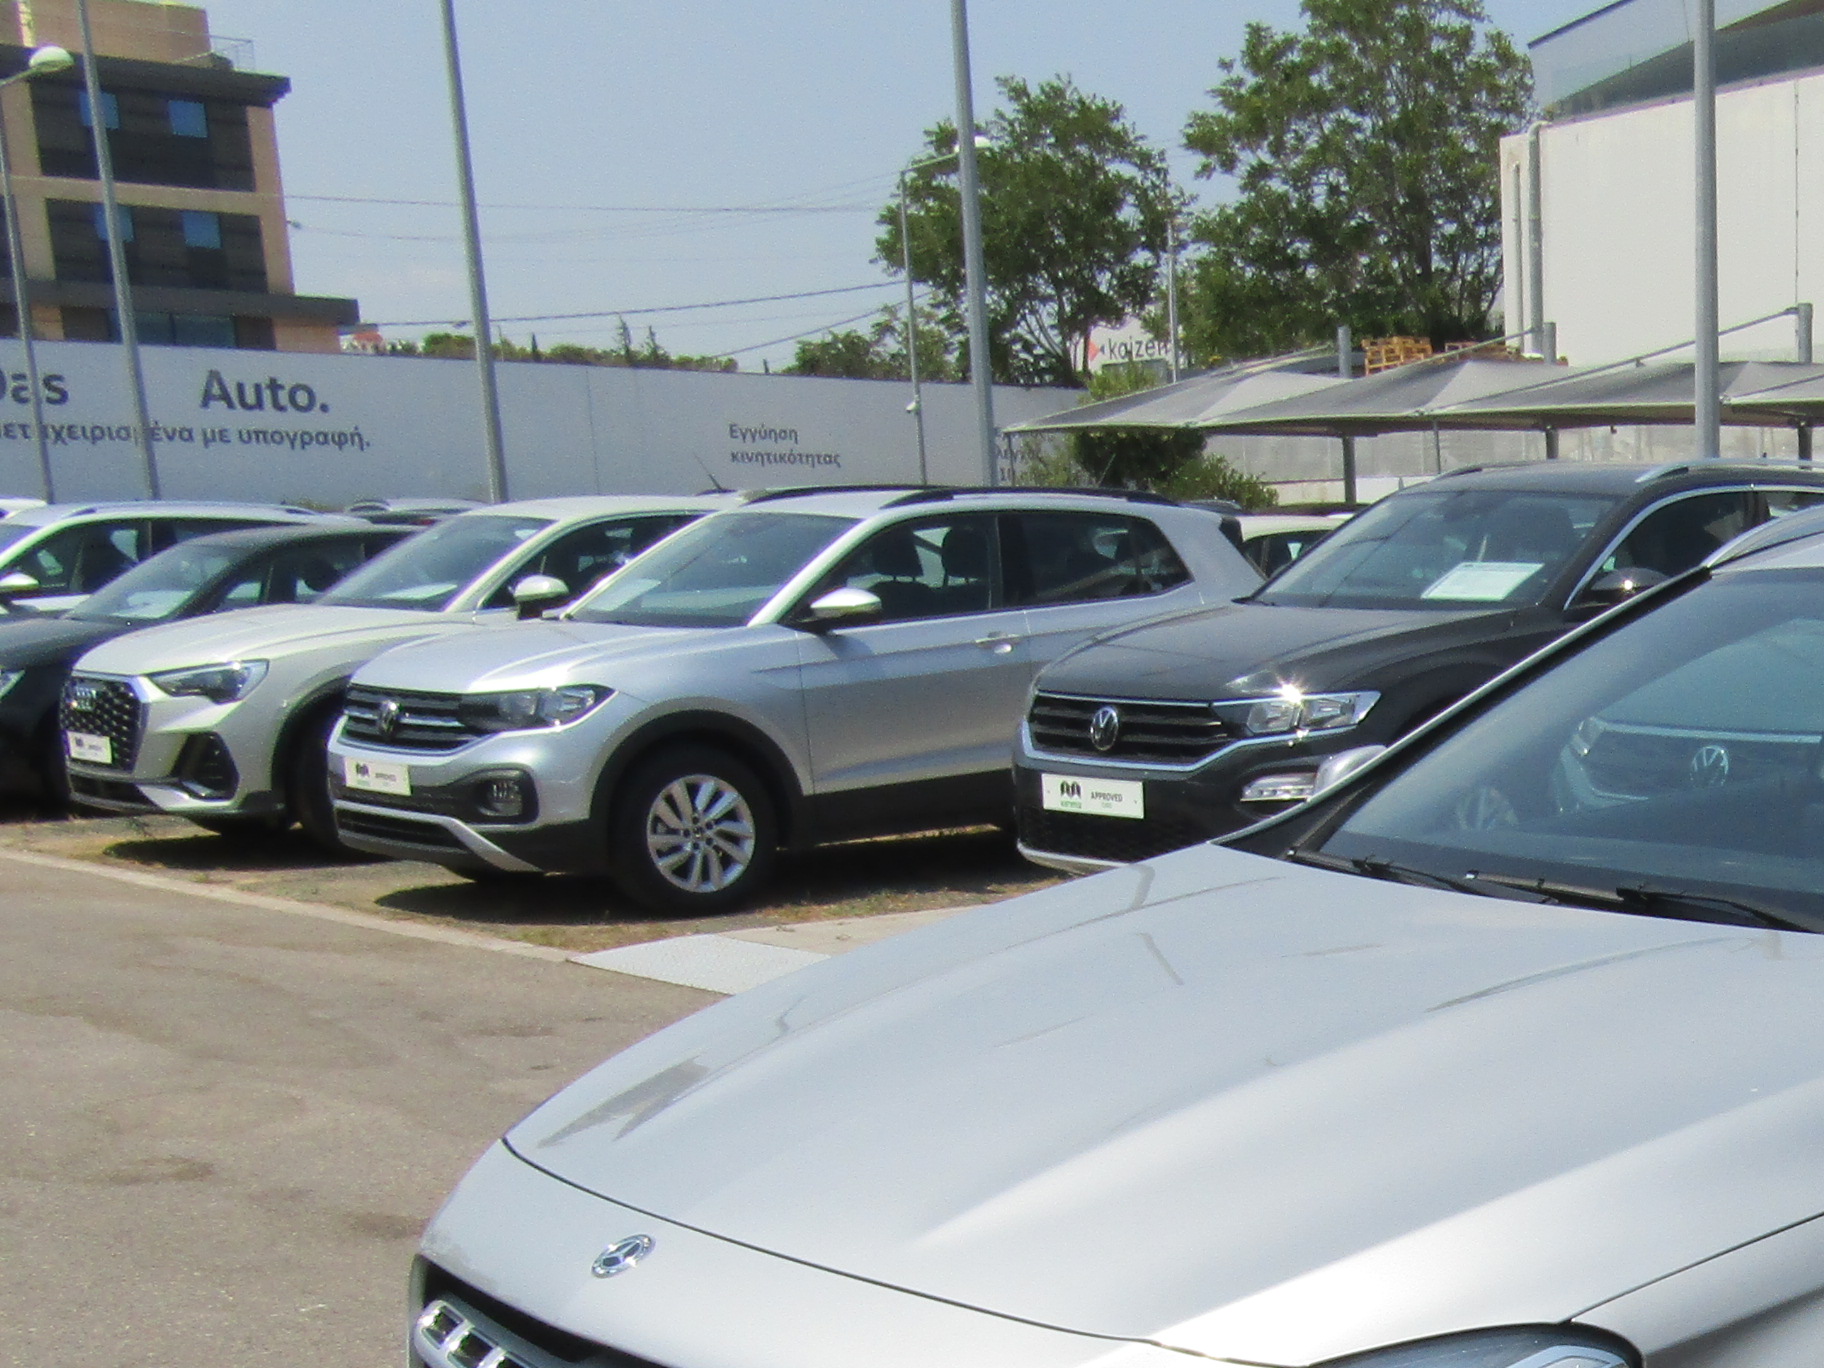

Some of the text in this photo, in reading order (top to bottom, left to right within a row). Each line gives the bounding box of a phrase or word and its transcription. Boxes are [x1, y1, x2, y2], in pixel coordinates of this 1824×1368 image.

[0, 368, 329, 413] as Auto.
[0, 421, 370, 451] ετχειρισένα με υπογραφή.
[729, 423, 798, 444] Εγγύηση
[731, 449, 841, 468] κινητικότητας
